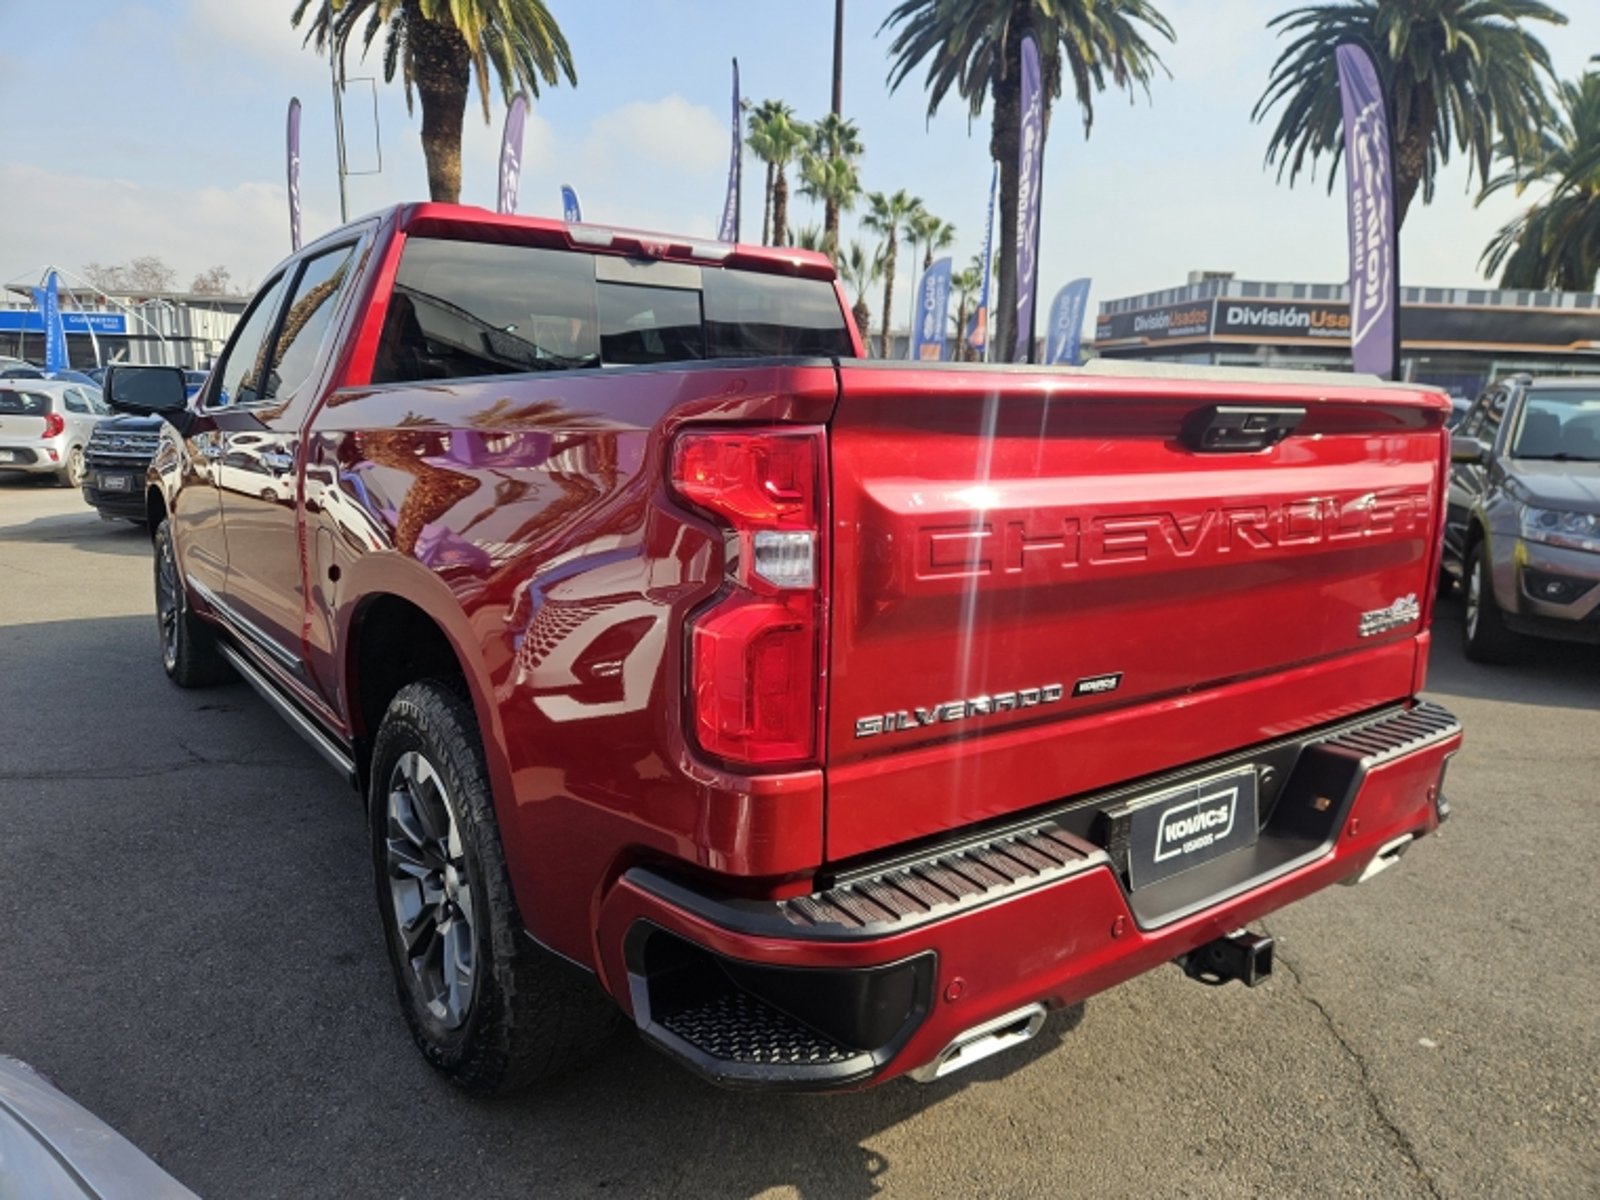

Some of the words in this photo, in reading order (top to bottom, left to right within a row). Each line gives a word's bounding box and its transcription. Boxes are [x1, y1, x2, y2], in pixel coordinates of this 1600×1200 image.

[915, 492, 1429, 581] CHEVROLET
[854, 683, 1063, 738] SILVERADO
[1165, 804, 1229, 843] KOVACS
